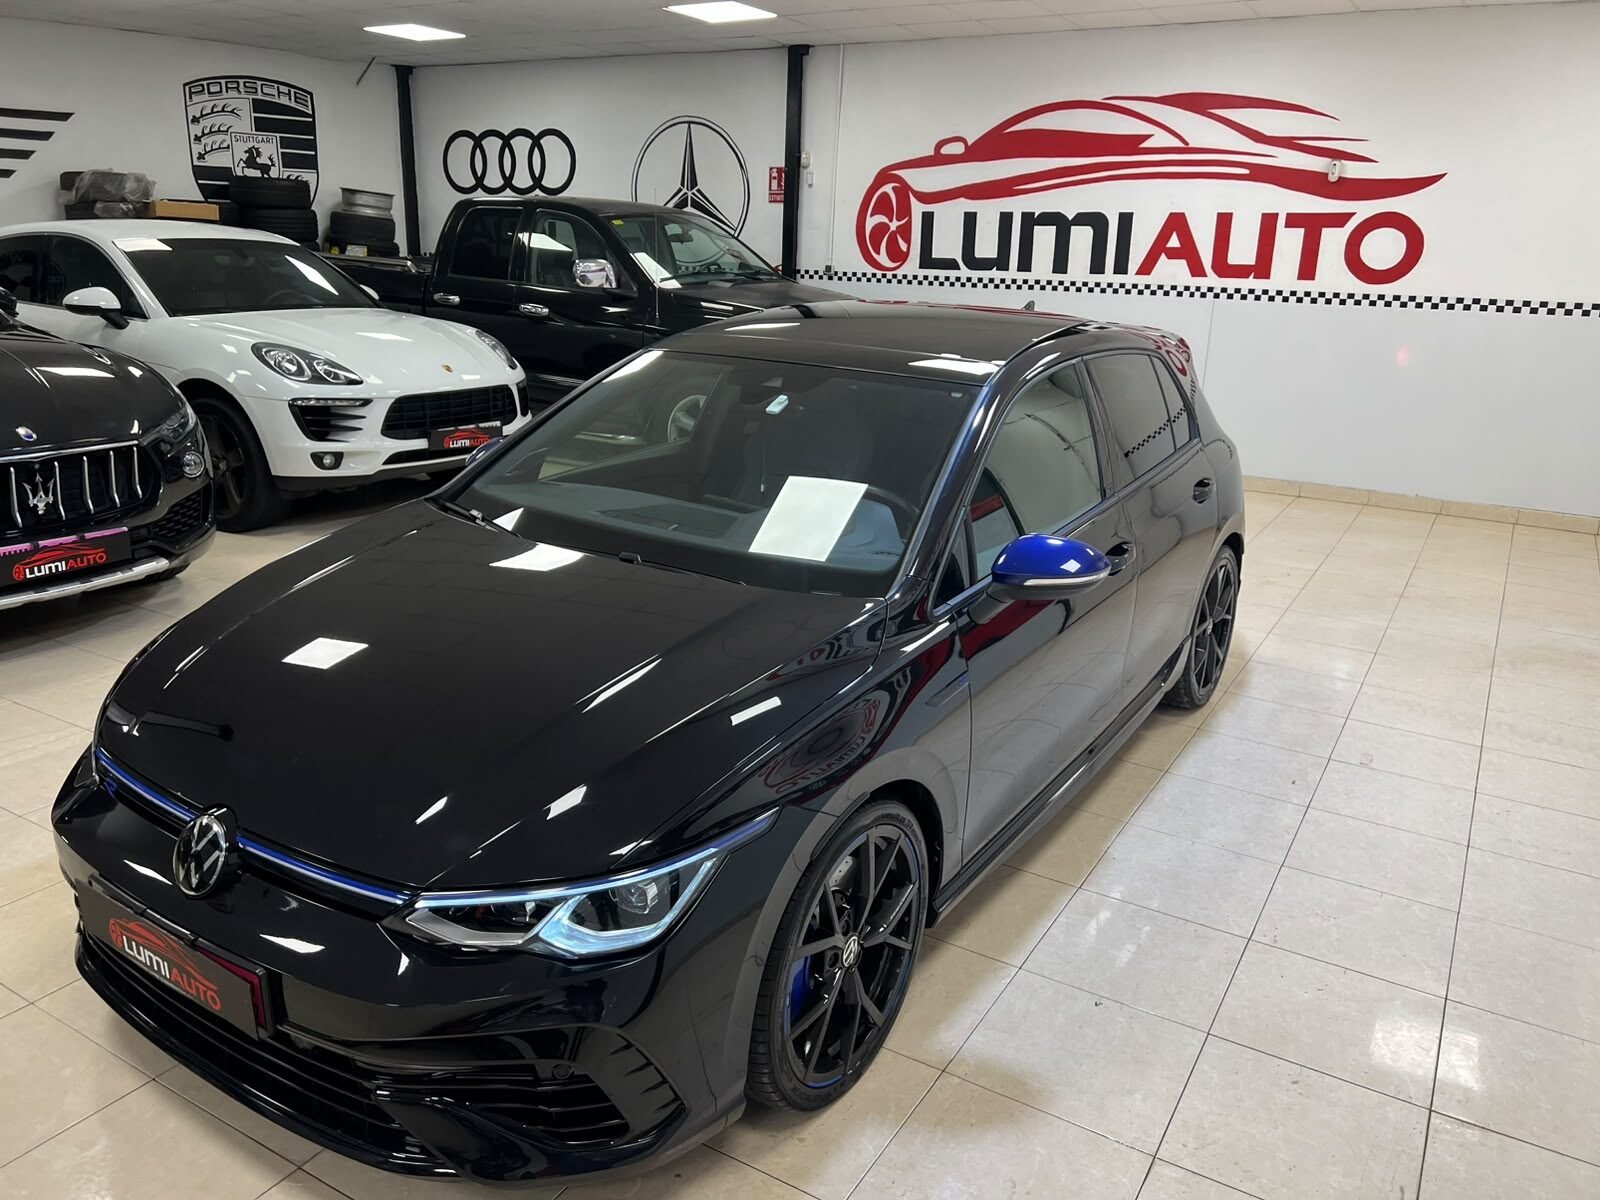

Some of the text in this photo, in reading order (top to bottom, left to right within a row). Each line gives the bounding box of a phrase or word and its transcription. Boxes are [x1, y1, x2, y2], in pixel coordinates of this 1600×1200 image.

[187, 80, 310, 111] PORSCHE
[233, 134, 274, 144] STUTTGART
[918, 210, 1425, 285] LUMIAUTO
[449, 437, 486, 448] LUMIAUT
[25, 552, 107, 579] LUMIAUTO
[122, 935, 222, 1011] LUMIAUTO
